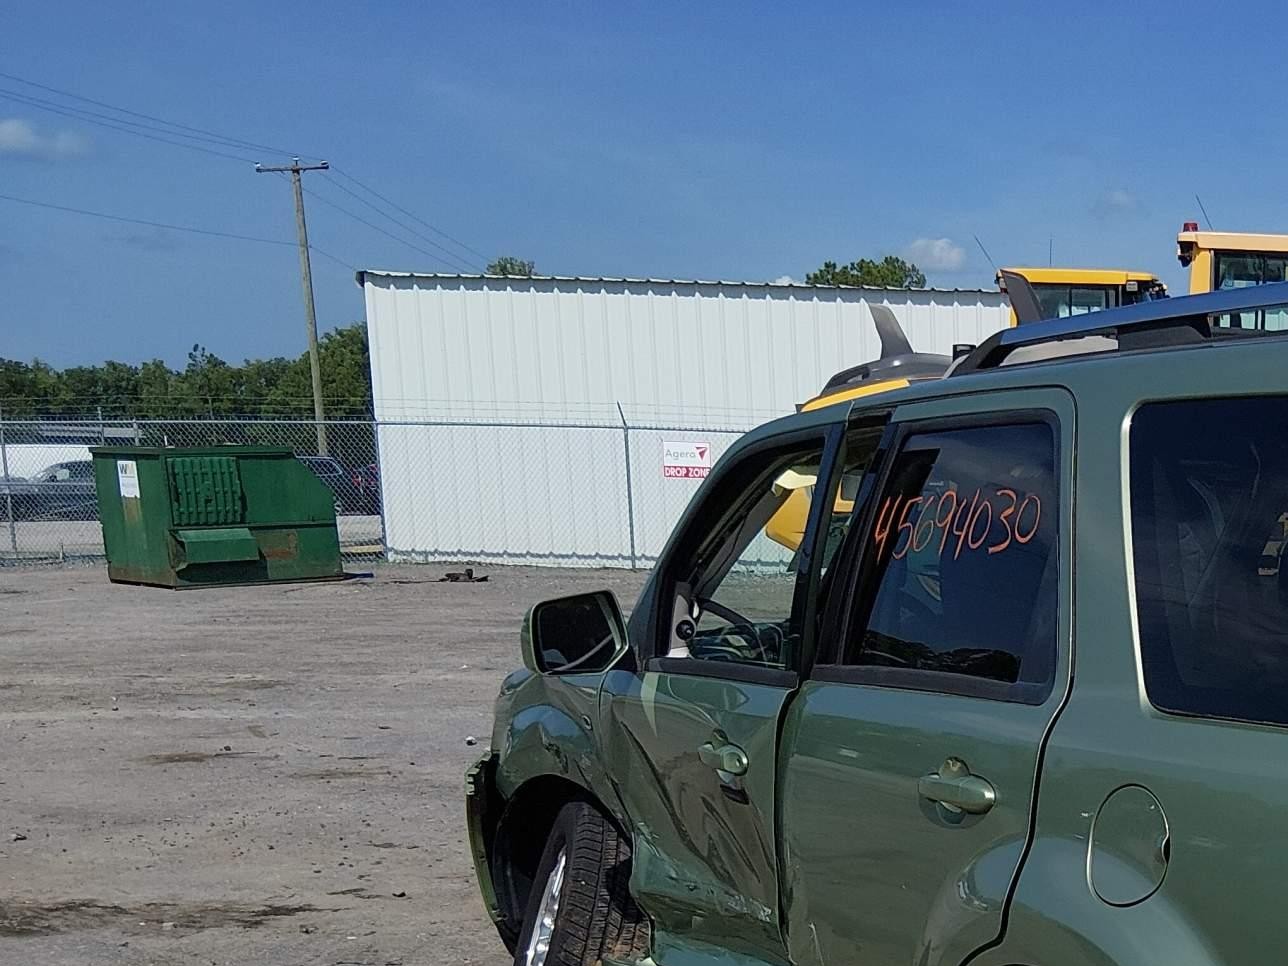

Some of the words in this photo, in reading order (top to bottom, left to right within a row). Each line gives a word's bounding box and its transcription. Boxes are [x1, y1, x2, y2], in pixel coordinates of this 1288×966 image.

[665, 448, 696, 460] Agero
[665, 467, 687, 477] DROP
[874, 487, 1042, 566] 45694030
